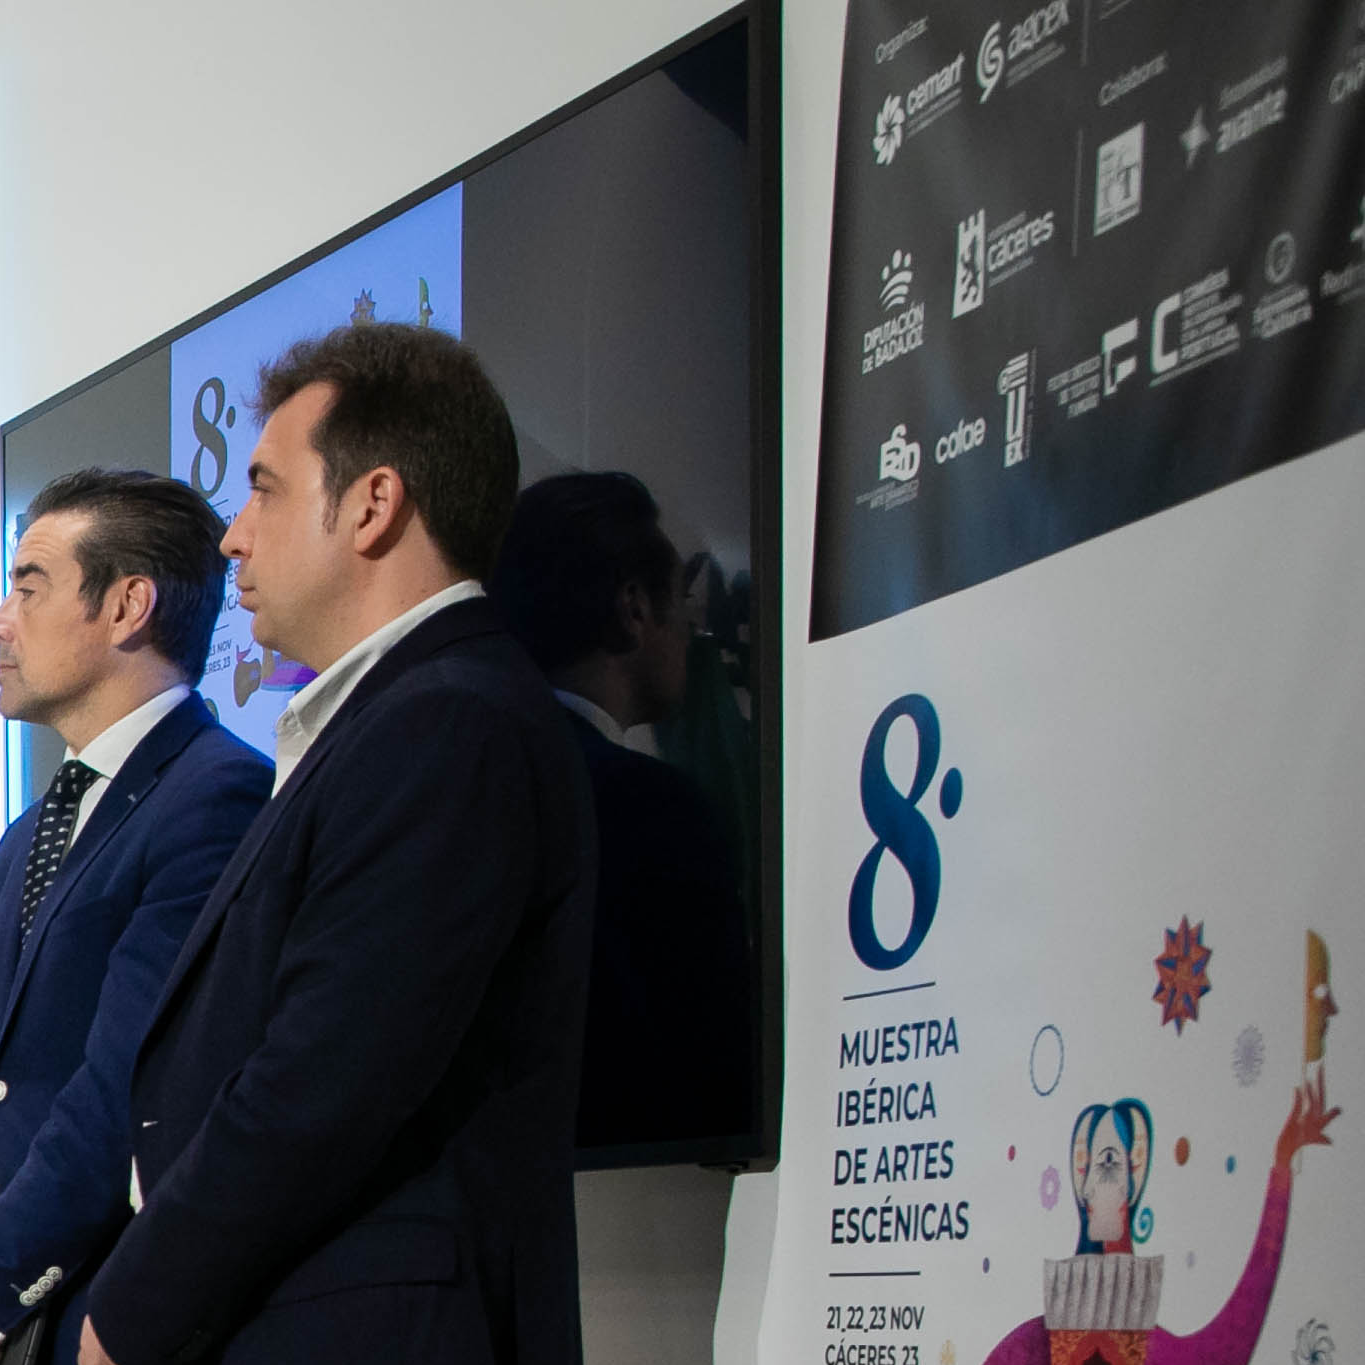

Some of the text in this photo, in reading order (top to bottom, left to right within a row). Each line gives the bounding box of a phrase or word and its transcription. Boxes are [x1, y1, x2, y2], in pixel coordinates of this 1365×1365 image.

[874, 323, 925, 368] BADAJOZ
[839, 1016, 959, 1068] MUESTRA
[836, 1078, 937, 1127] IBÉRICA
[833, 1139, 955, 1186] DE ARTES
[829, 1194, 970, 1245] ESCÉNICAS
[890, 1305, 925, 1330] NOV
